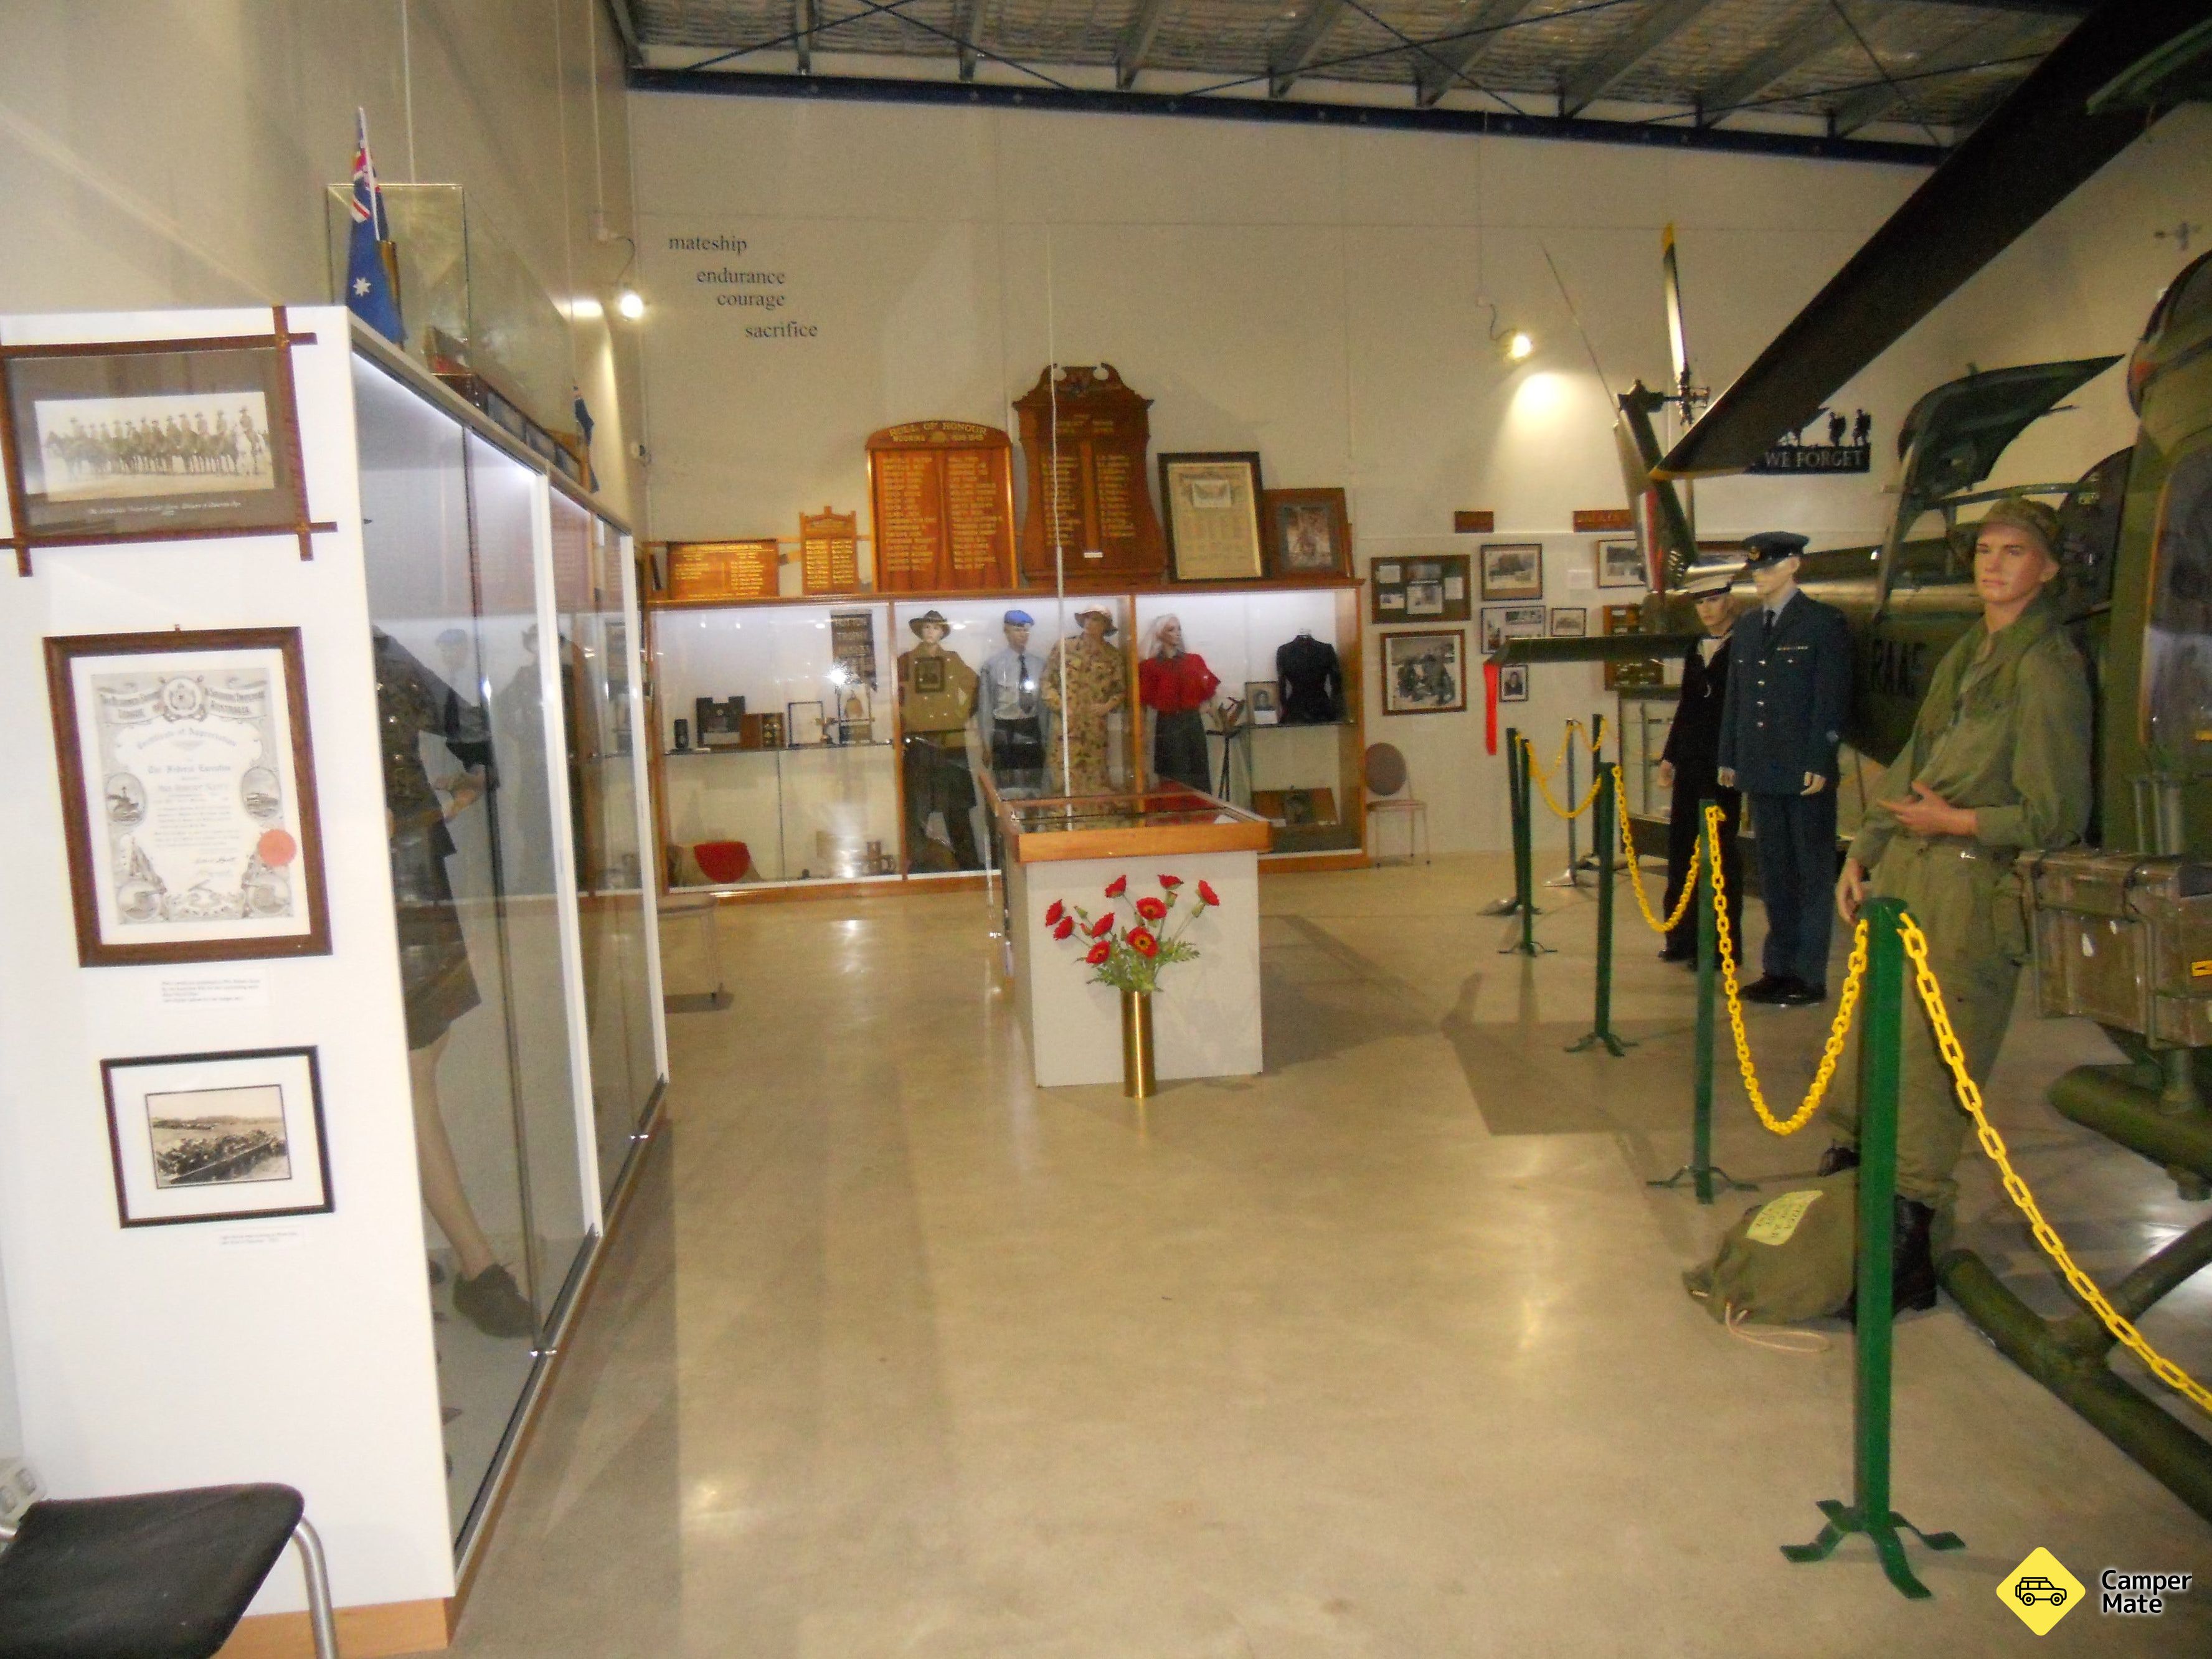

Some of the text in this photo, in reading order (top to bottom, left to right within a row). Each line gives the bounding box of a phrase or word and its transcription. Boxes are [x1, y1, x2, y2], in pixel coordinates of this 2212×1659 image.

[669, 235, 747, 255] mateship
[697, 268, 785, 284] endurance
[717, 295, 785, 310] courage
[745, 321, 818, 338] sacrifice
[923, 422, 938, 430] OF
[942, 422, 986, 435] HONOUR
[1765, 450, 1863, 467] WE FORGET
